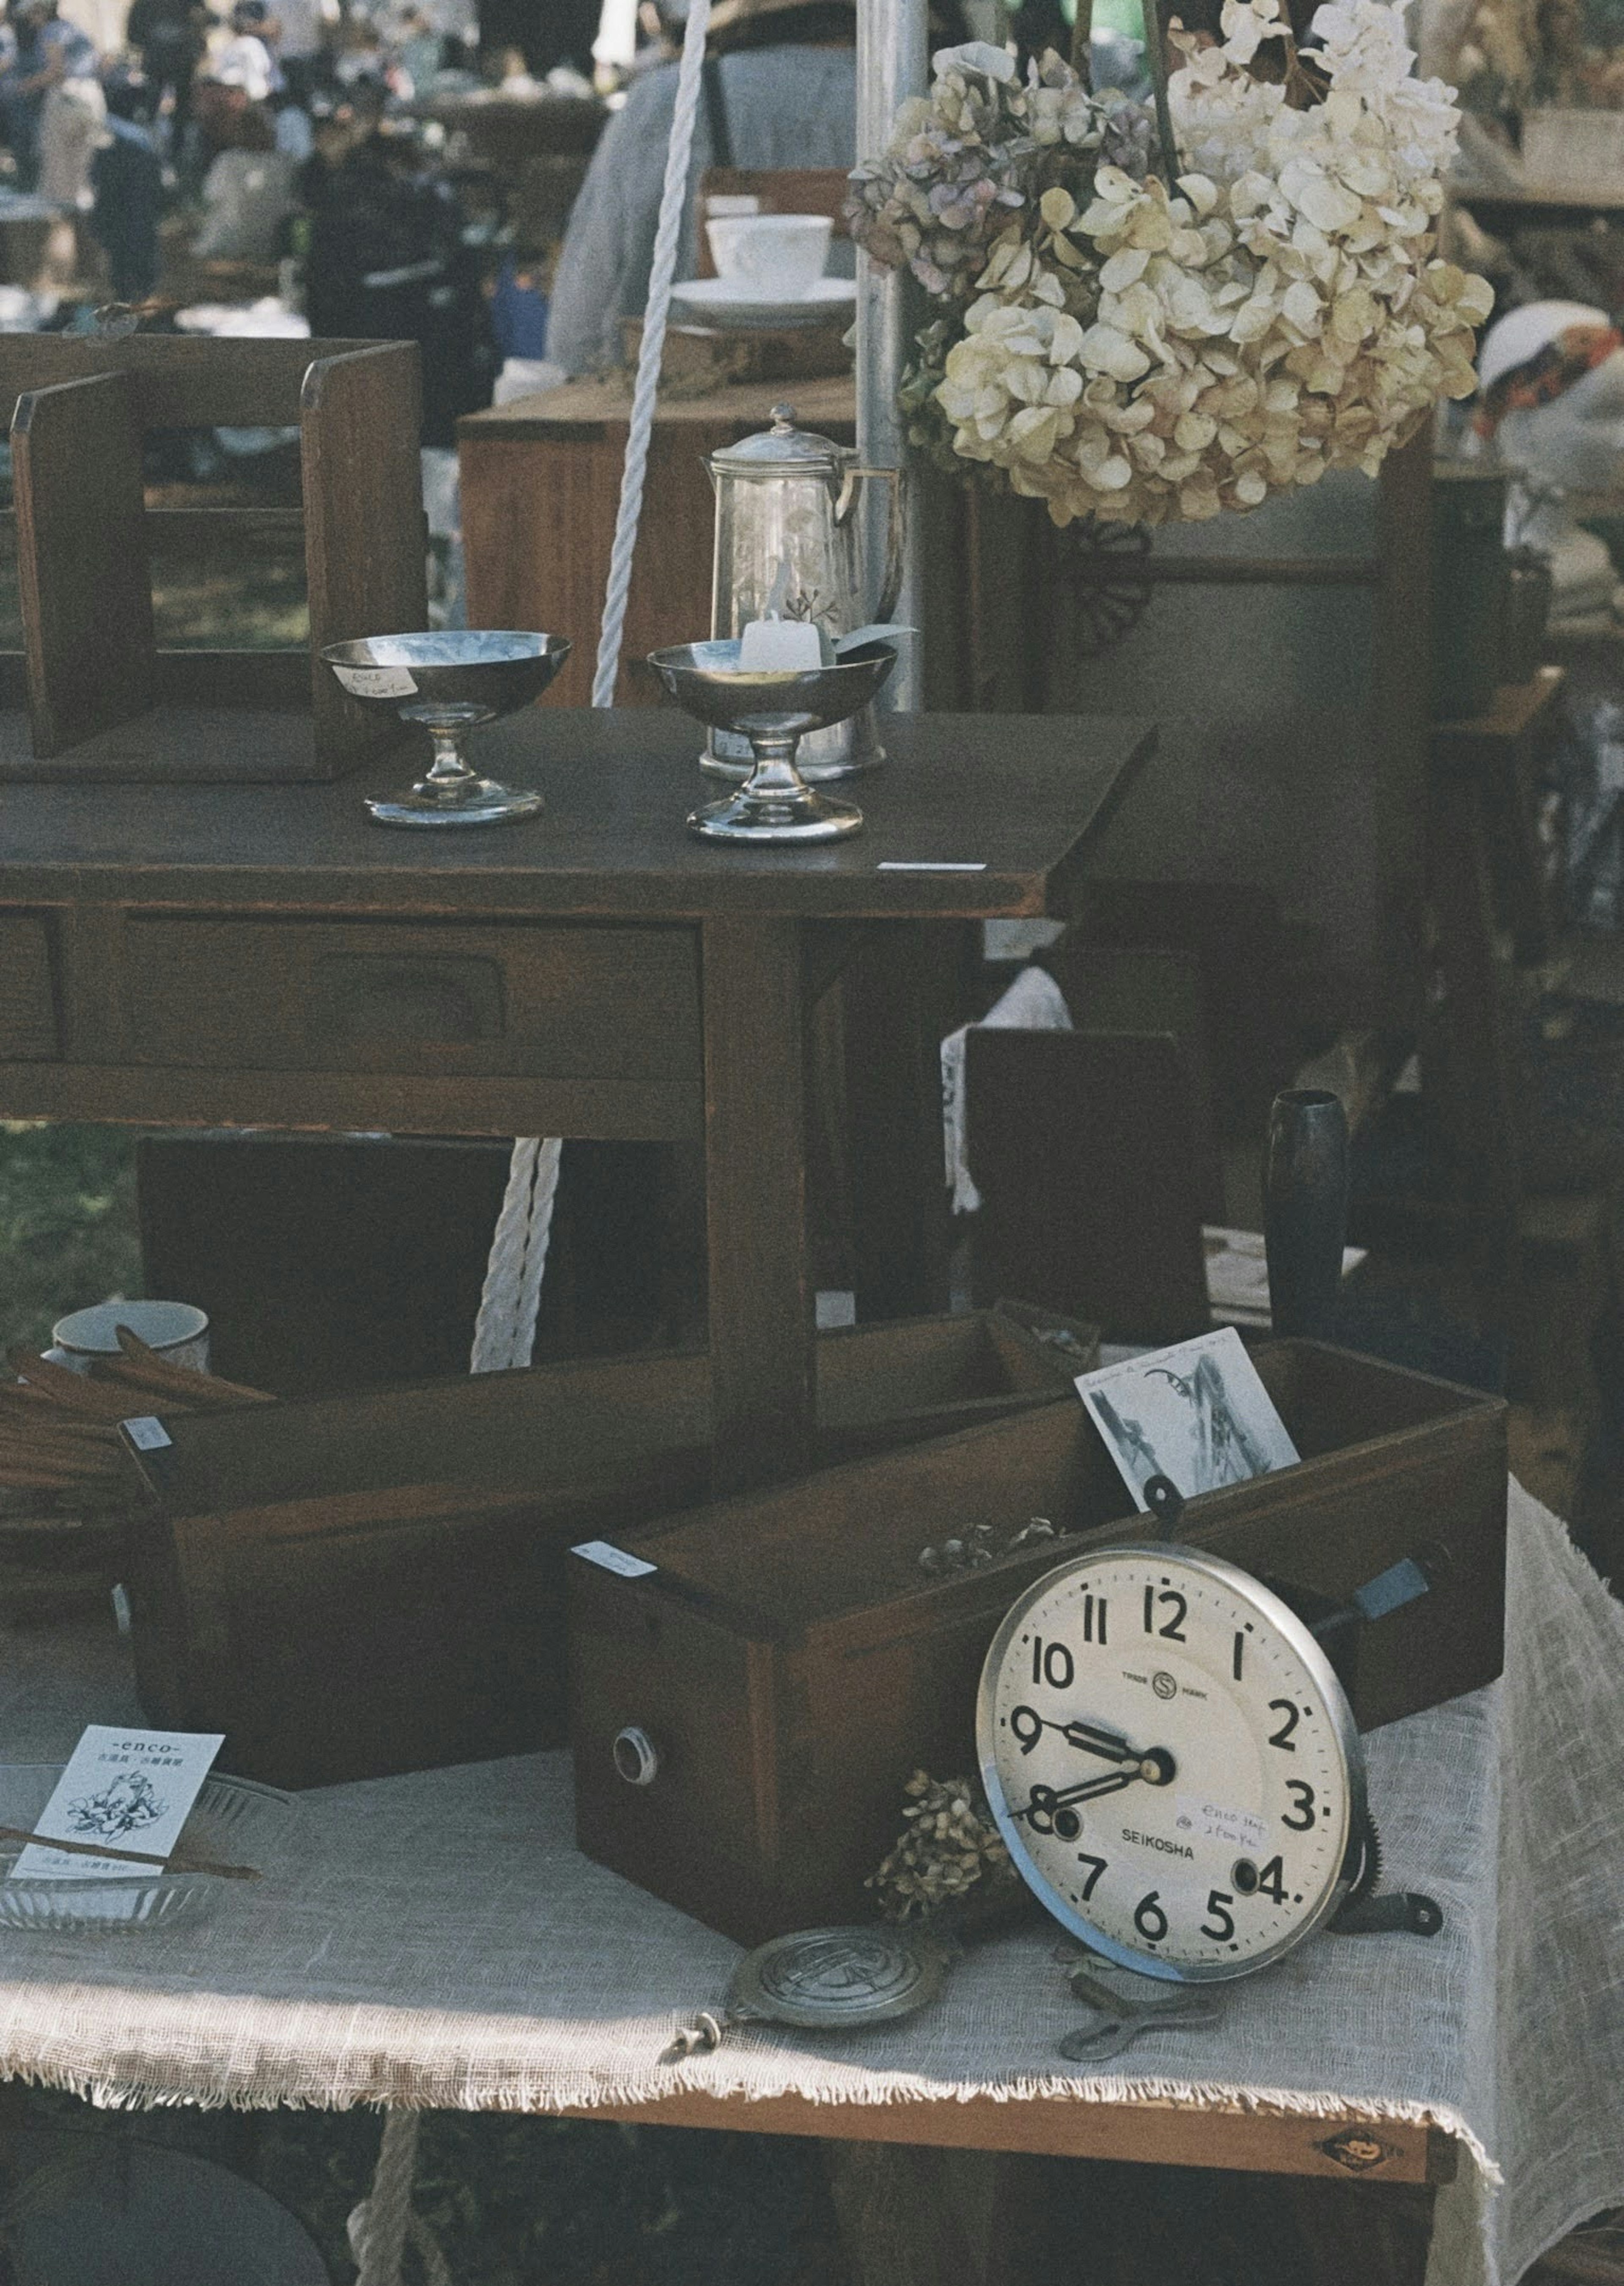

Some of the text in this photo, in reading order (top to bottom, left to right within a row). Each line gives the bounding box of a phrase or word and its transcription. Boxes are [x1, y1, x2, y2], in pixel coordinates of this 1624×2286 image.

[1084, 1594, 1107, 1645] 11
[1143, 1585, 1187, 1643] 12
[1033, 1636, 1074, 1688] 10
[1233, 1631, 1244, 1681] 1
[1010, 1705, 1043, 1755] 9
[1268, 1699, 1300, 1752] 2
[1026, 1784, 1058, 1834] 8
[1281, 1779, 1315, 1831] 3
[1122, 1828, 1194, 1861] SEIKOSHA
[1077, 1853, 1108, 1901] 7
[1259, 1855, 1289, 1905] 4
[1134, 1891, 1168, 1941] 6
[1200, 1890, 1234, 1941] 5
